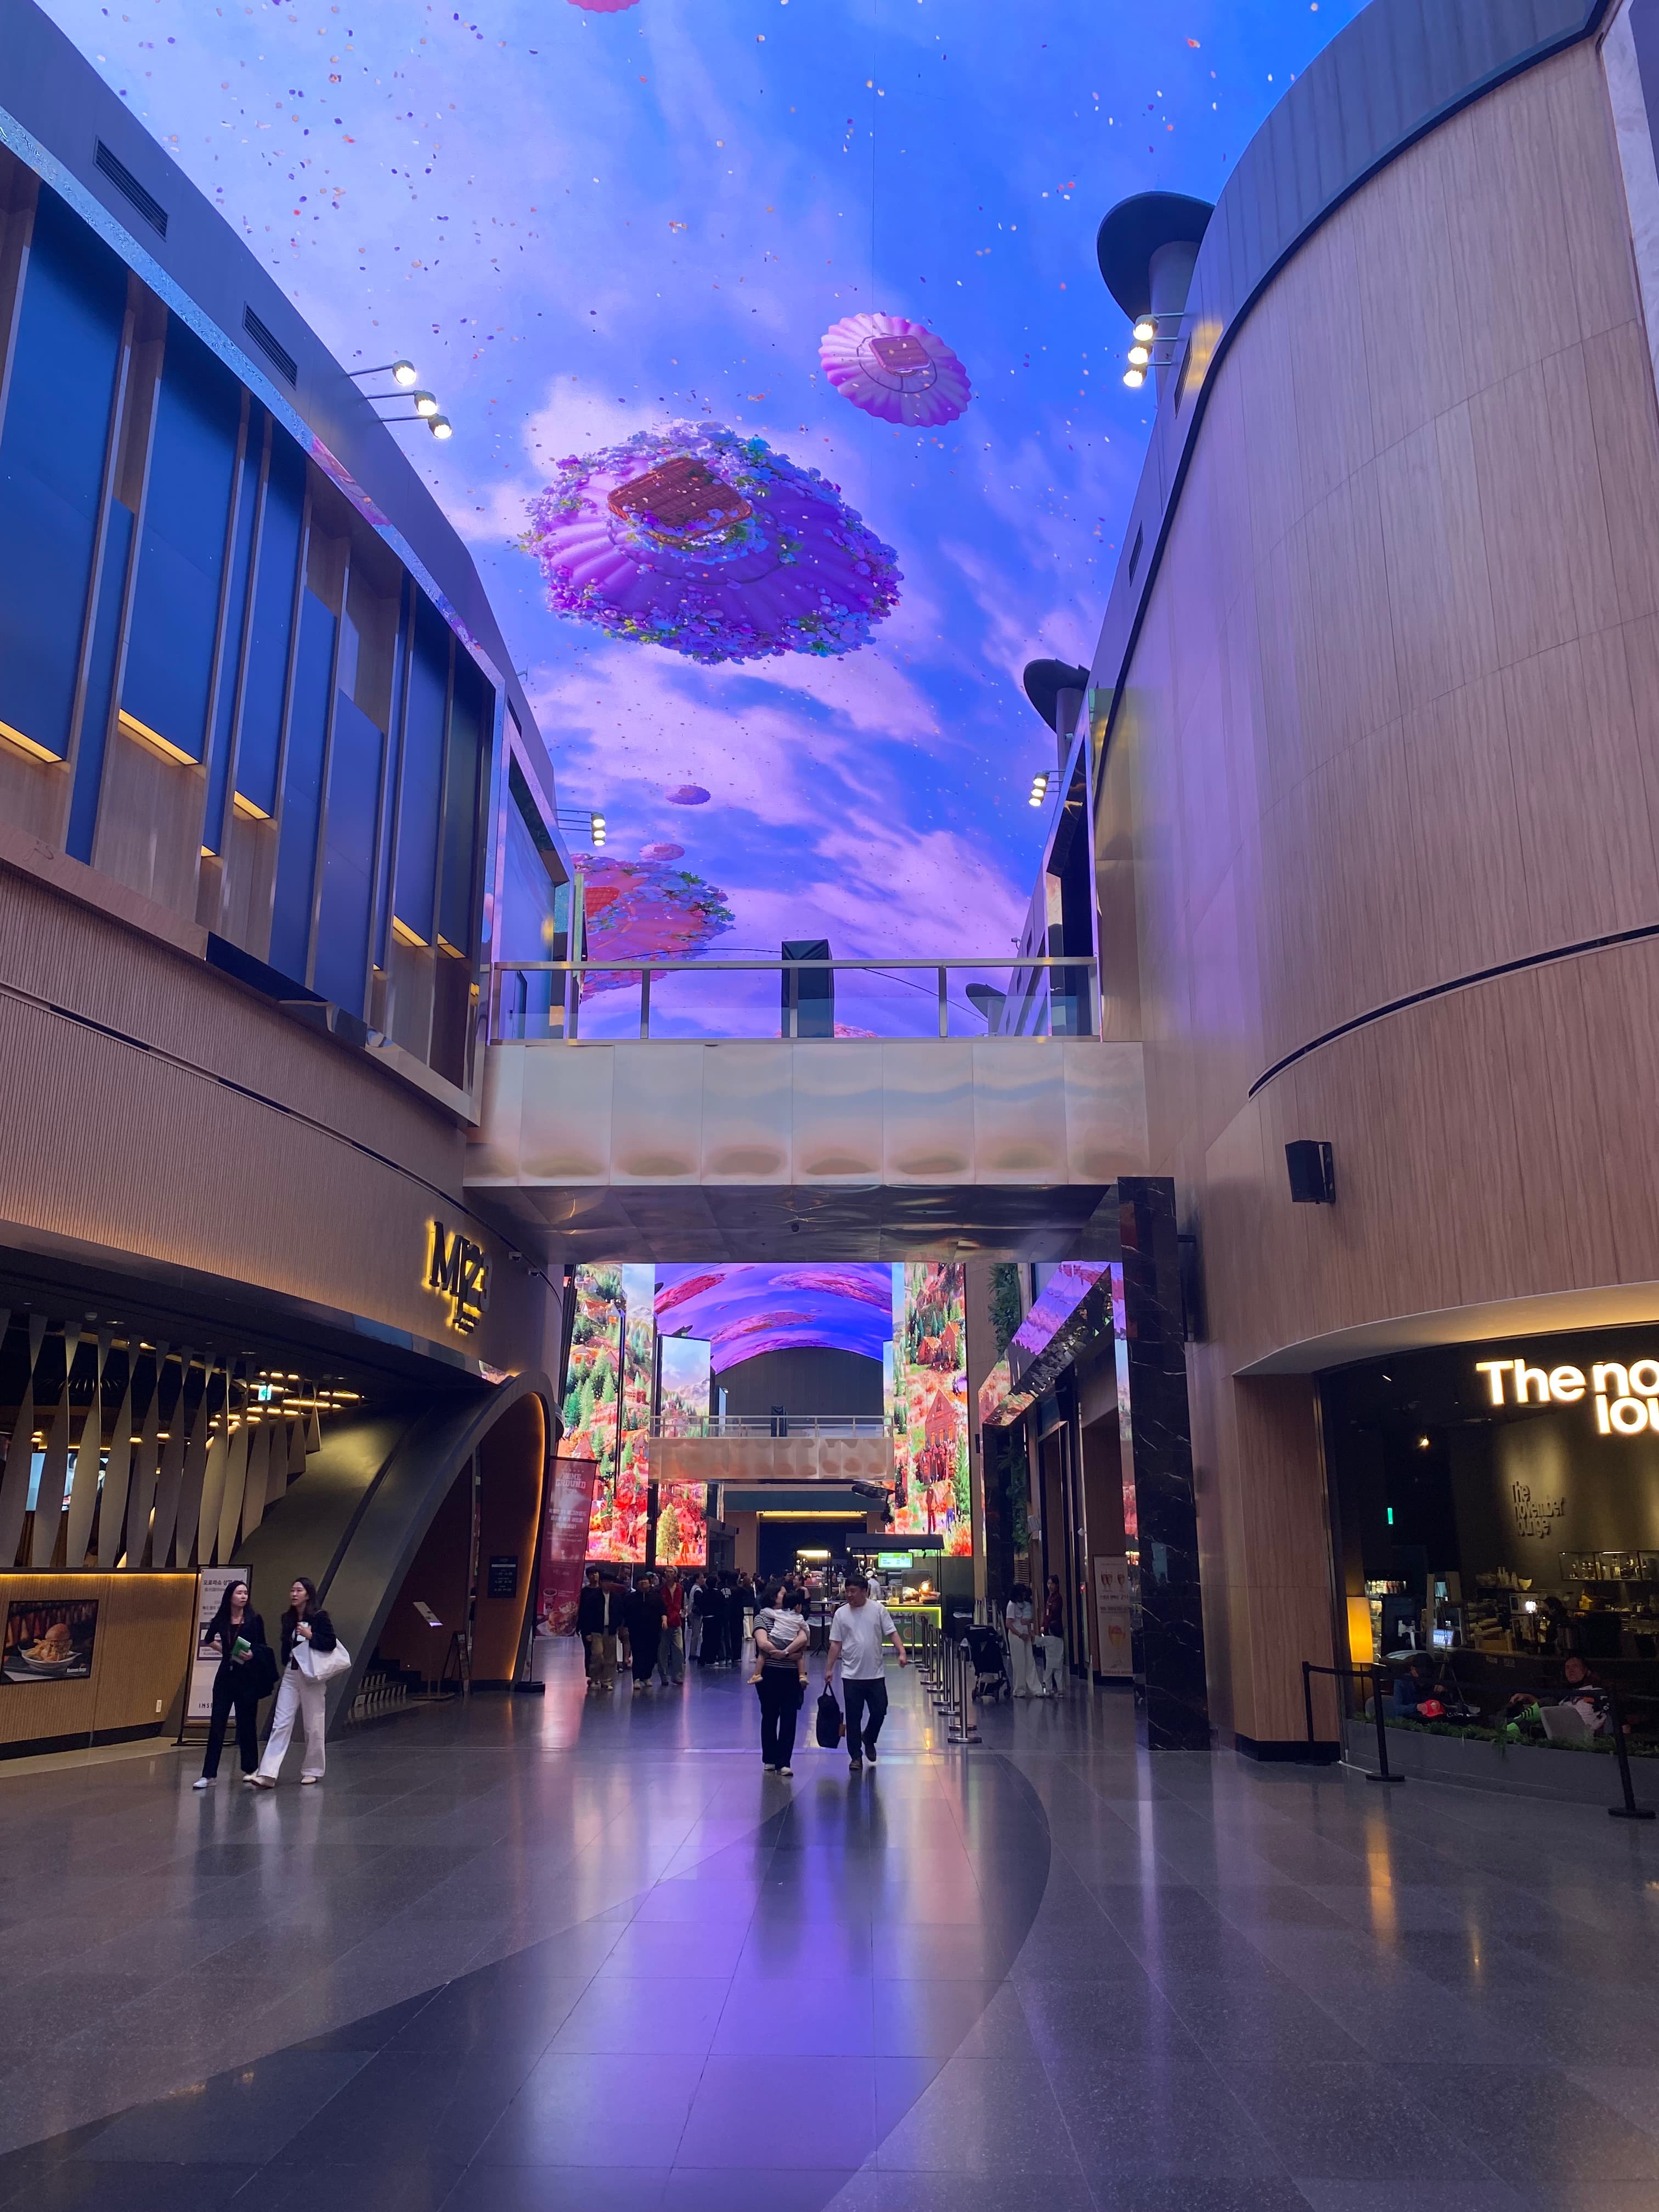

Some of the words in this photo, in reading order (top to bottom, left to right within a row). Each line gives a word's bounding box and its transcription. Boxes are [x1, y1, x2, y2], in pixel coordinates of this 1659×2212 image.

[1476, 1358, 1587, 1406] The
[555, 1479, 586, 1489] GROUND
[1511, 1481, 1531, 1503] The
[1513, 1496, 1564, 1519] november
